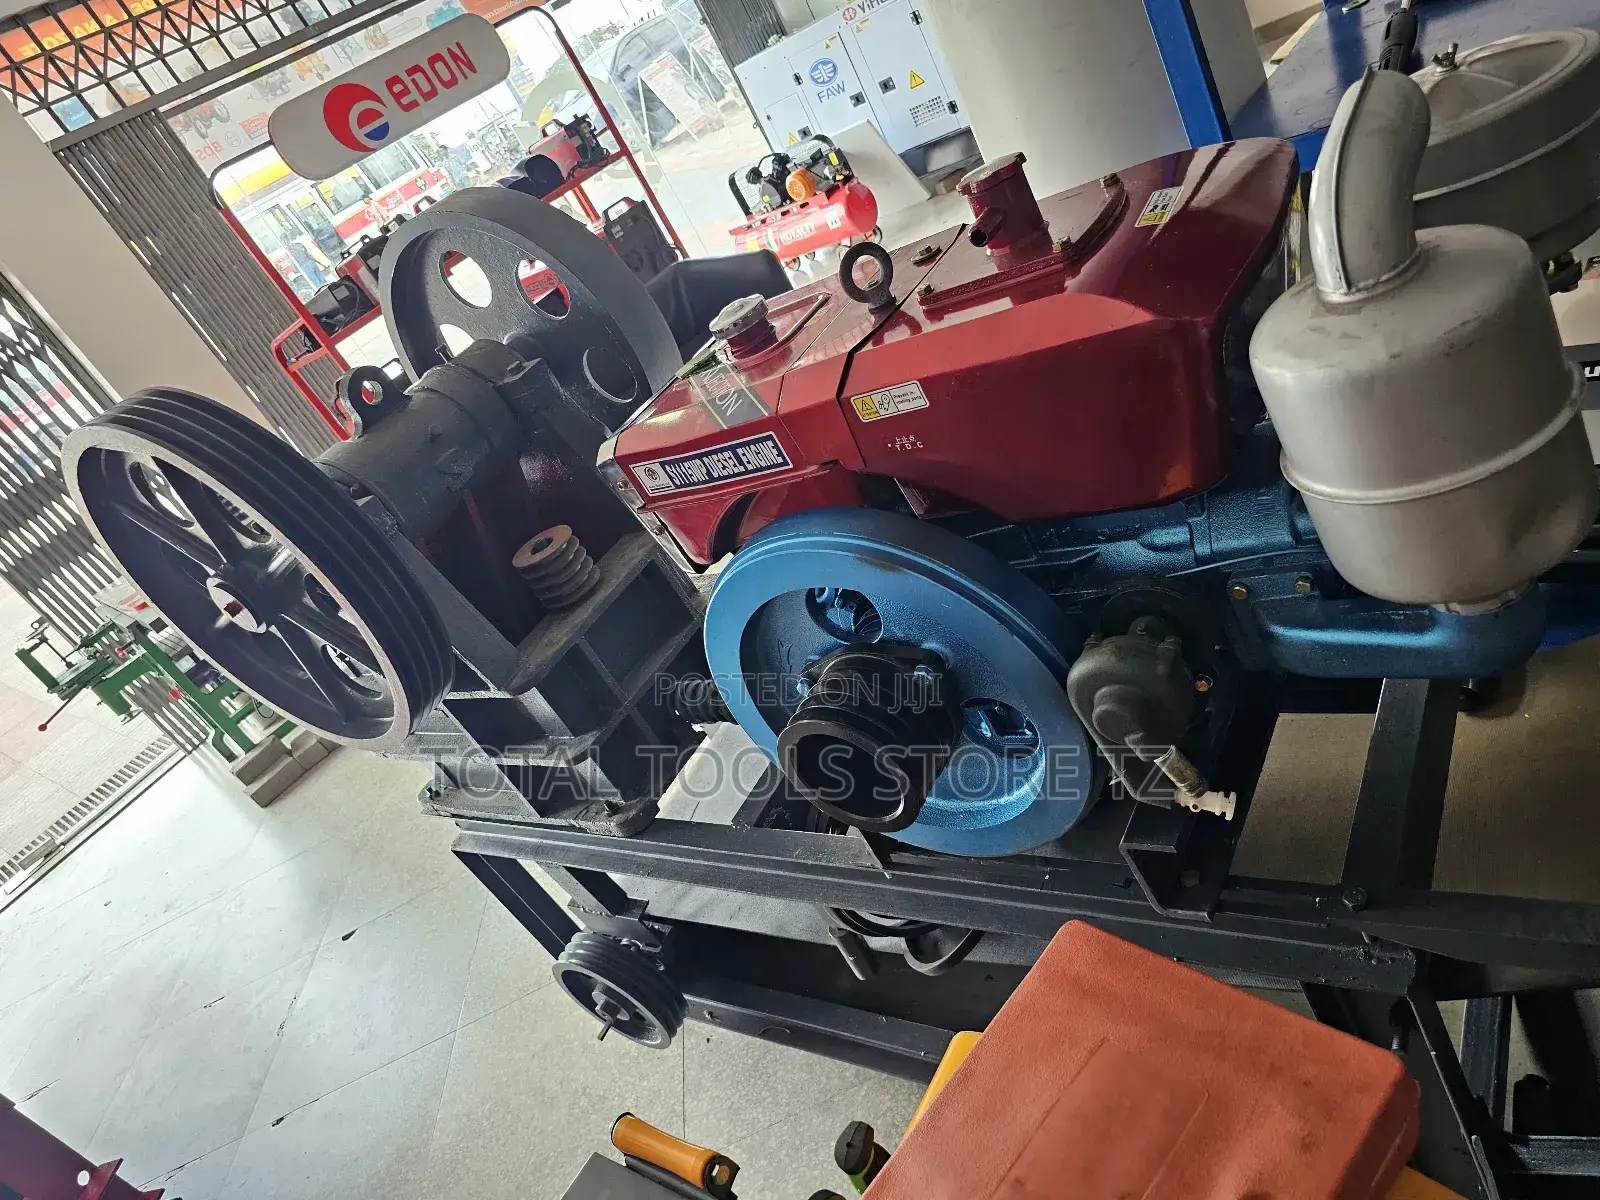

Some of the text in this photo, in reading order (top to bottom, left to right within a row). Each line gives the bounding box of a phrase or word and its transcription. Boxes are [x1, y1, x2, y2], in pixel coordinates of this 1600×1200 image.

[817, 81, 846, 103] FAW
[706, 450, 746, 479] DIESEL
[736, 440, 785, 470] ENGINE
